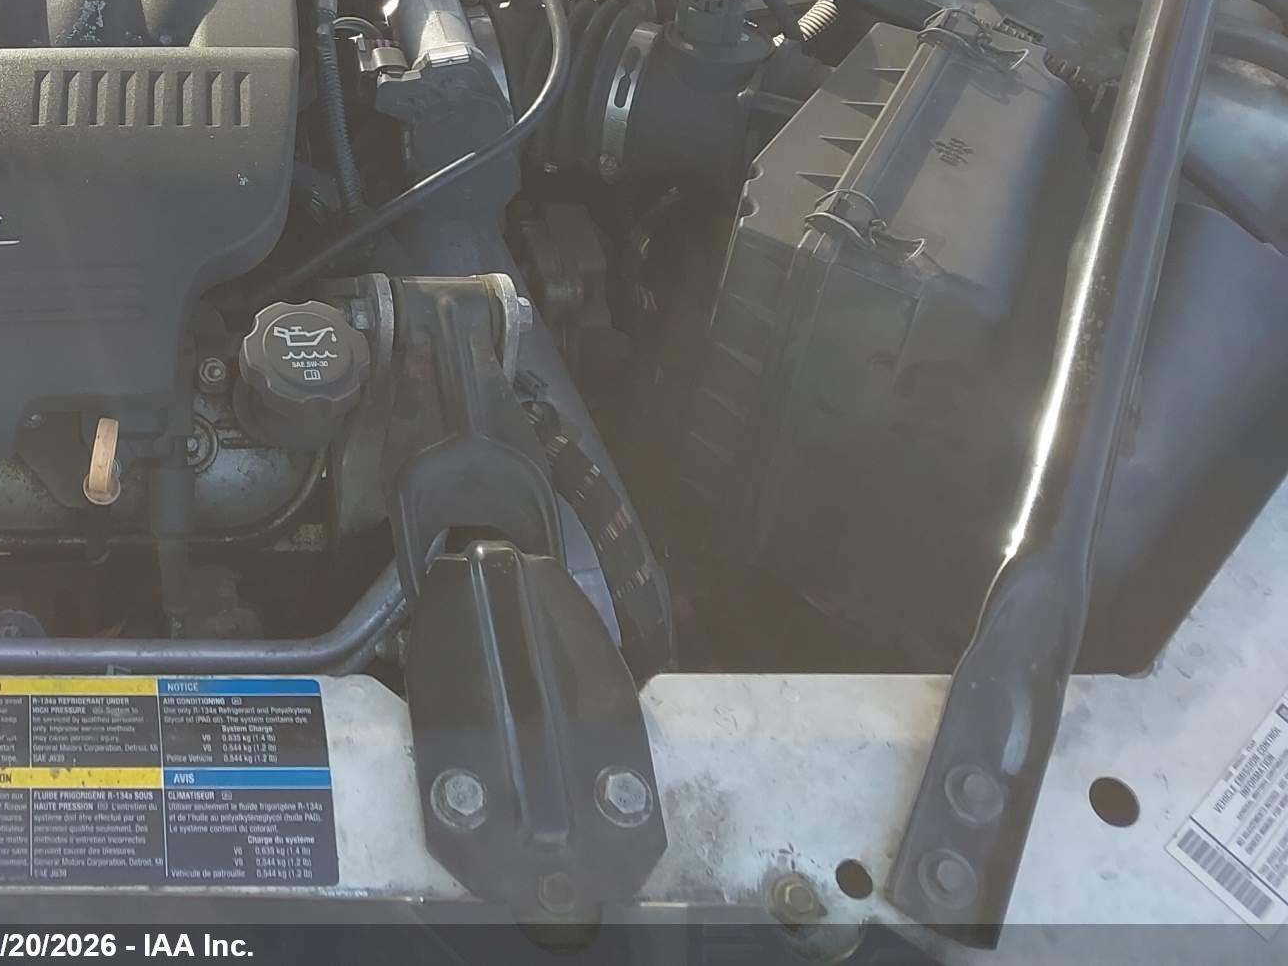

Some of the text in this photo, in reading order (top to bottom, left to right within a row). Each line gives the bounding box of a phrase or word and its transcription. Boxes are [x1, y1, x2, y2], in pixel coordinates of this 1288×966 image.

[167, 683, 199, 691] NOTICE
[1212, 784, 1238, 814] VEHICLE
[1232, 752, 1261, 786] EMISSION
[1255, 725, 1282, 755] CONTROL
[174, 774, 194, 783] AVIS
[1238, 753, 1276, 798] INFORMATION
[168, 792, 214, 800] CLIMATISEUR
